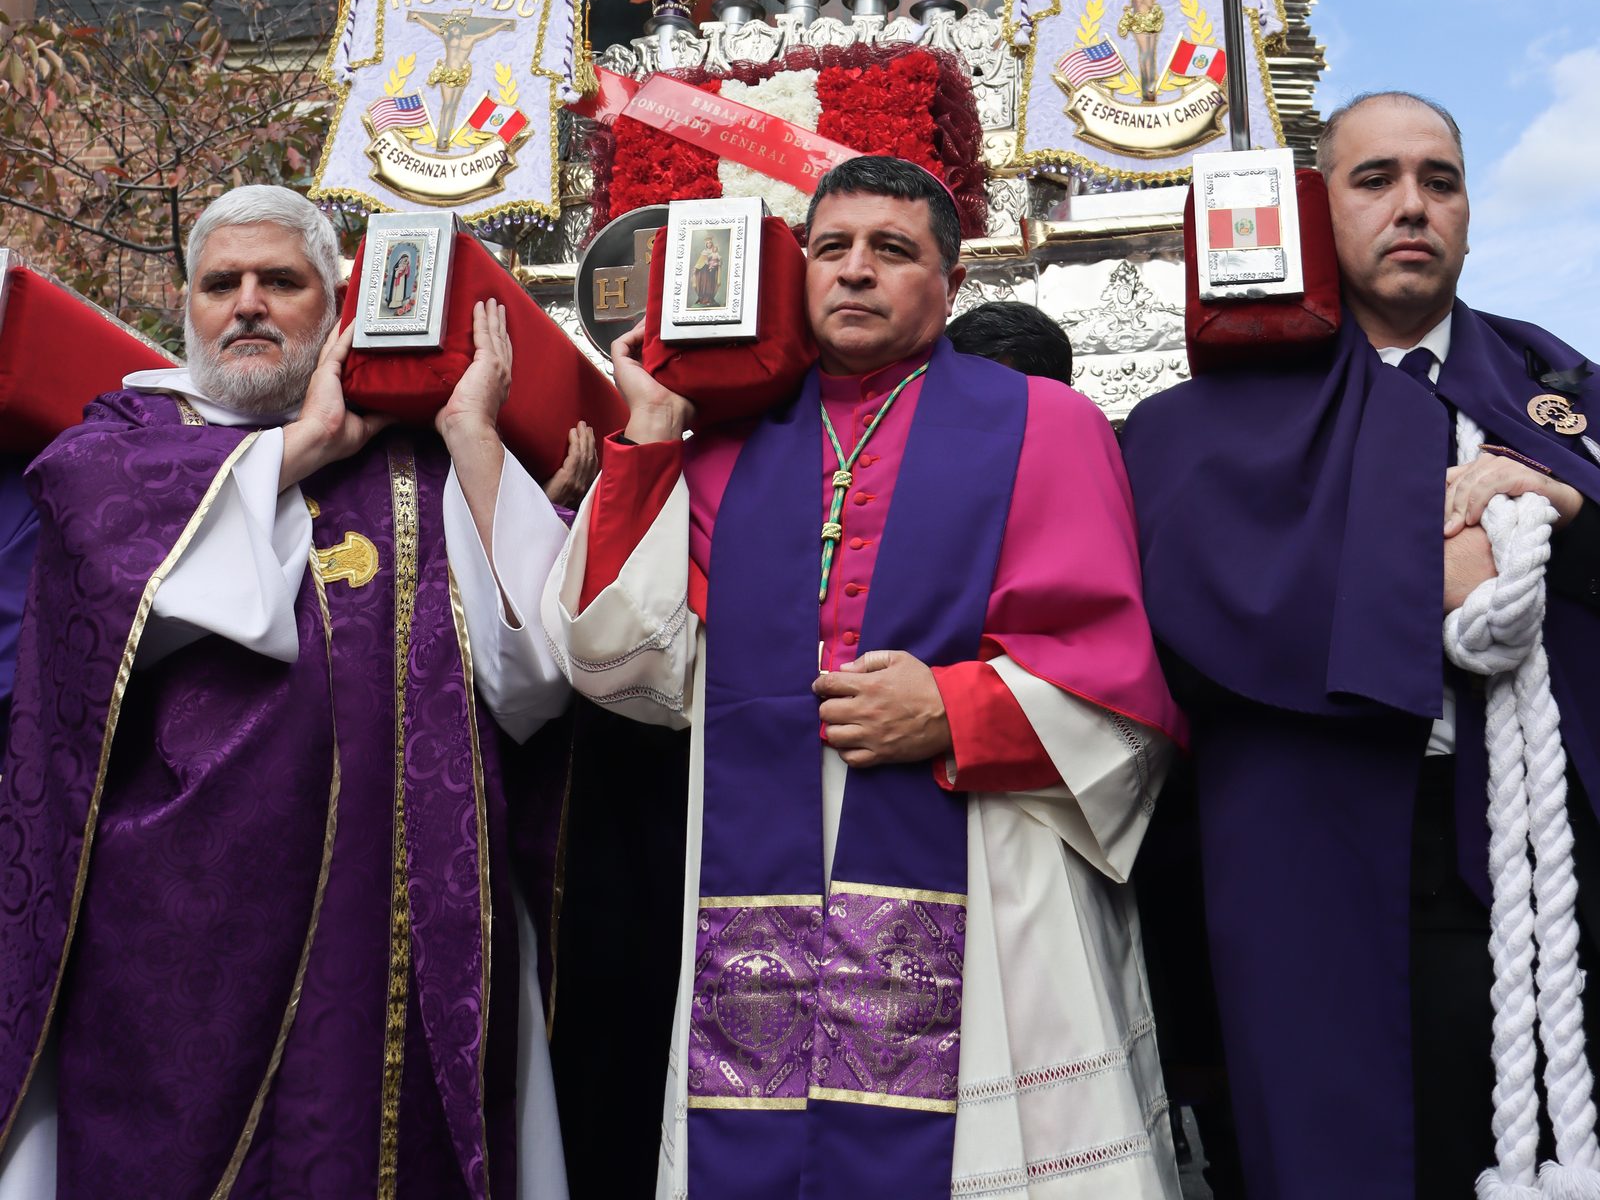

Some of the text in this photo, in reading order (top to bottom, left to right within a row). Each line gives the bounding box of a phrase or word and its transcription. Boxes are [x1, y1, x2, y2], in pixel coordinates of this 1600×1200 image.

[690, 96, 766, 134] EMBAJADA
[1074, 90, 1224, 129] FE ESPERANZA Y CARIDAD
[630, 97, 711, 136] CONSULADO
[719, 130, 788, 166] GENERAL
[374, 138, 509, 178] FE ESPERANZA Y CARIDAD
[596, 276, 629, 310] H
